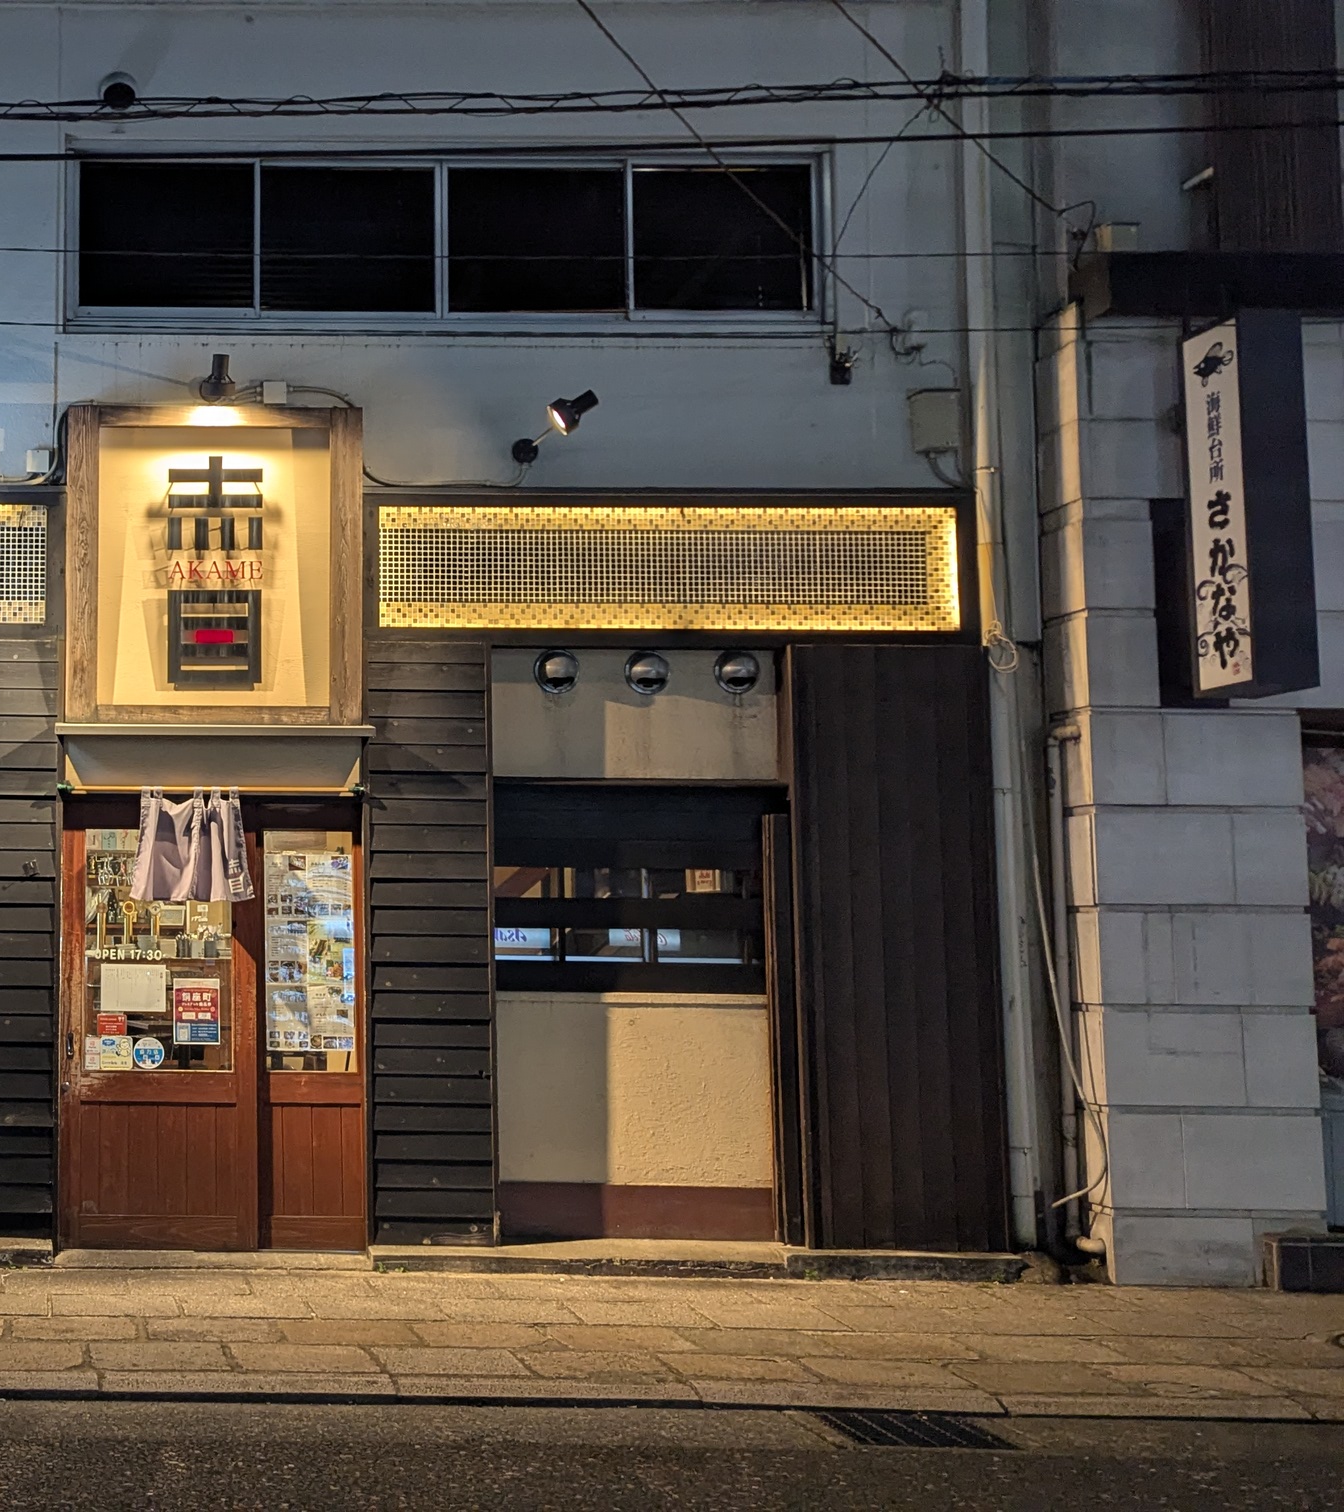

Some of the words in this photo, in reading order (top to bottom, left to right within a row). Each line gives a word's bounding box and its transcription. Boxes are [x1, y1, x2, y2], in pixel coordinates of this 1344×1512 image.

[1205, 390, 1224, 484] 海鮮台所
[168, 560, 263, 580] AKAME
[1207, 489, 1240, 670] さかなや
[95, 949, 125, 960] OPEN
